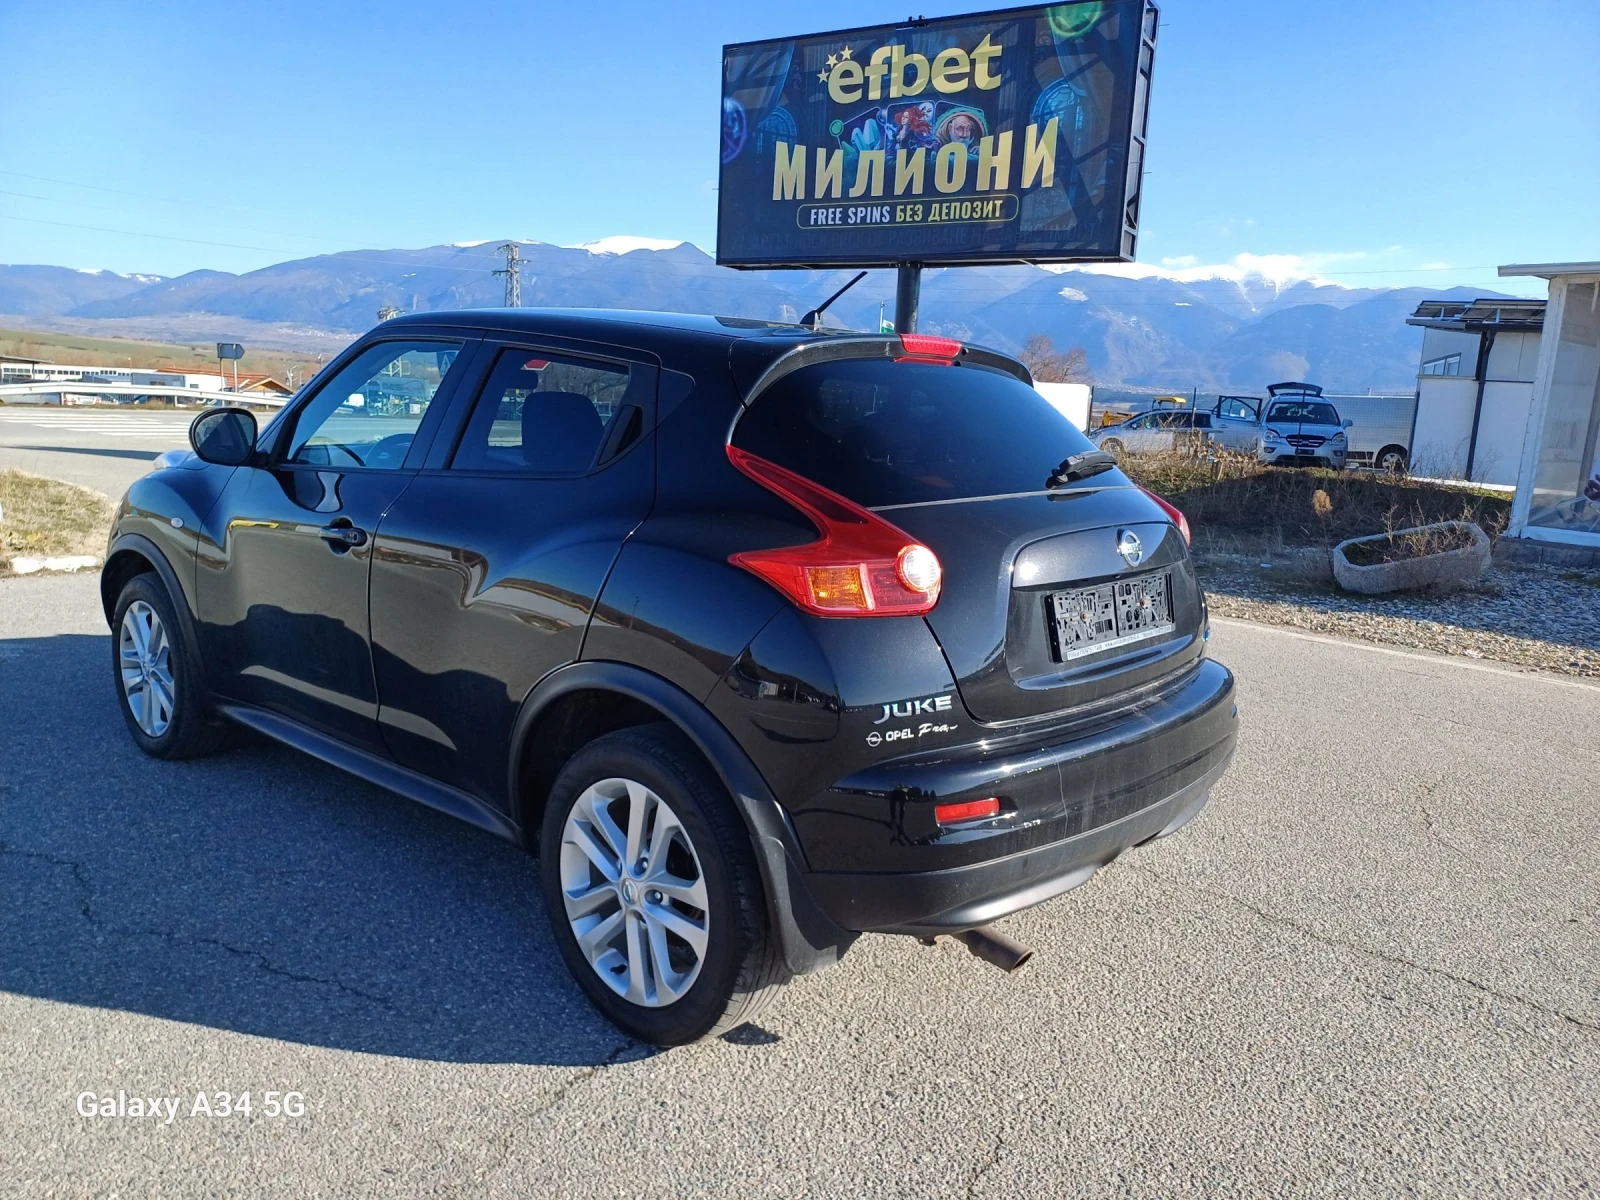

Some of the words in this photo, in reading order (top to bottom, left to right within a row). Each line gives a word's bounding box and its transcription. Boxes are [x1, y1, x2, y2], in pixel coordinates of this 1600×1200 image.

[827, 33, 1002, 104] efbet
[772, 117, 1059, 201] МИЛИОНИ
[810, 207, 843, 225] FREE
[847, 205, 891, 224] SPINS
[895, 203, 923, 222] БЕЗ
[928, 200, 1004, 222] ДЕПОЗИТ
[872, 695, 953, 724] JUKE
[885, 728, 915, 742] OPEL
